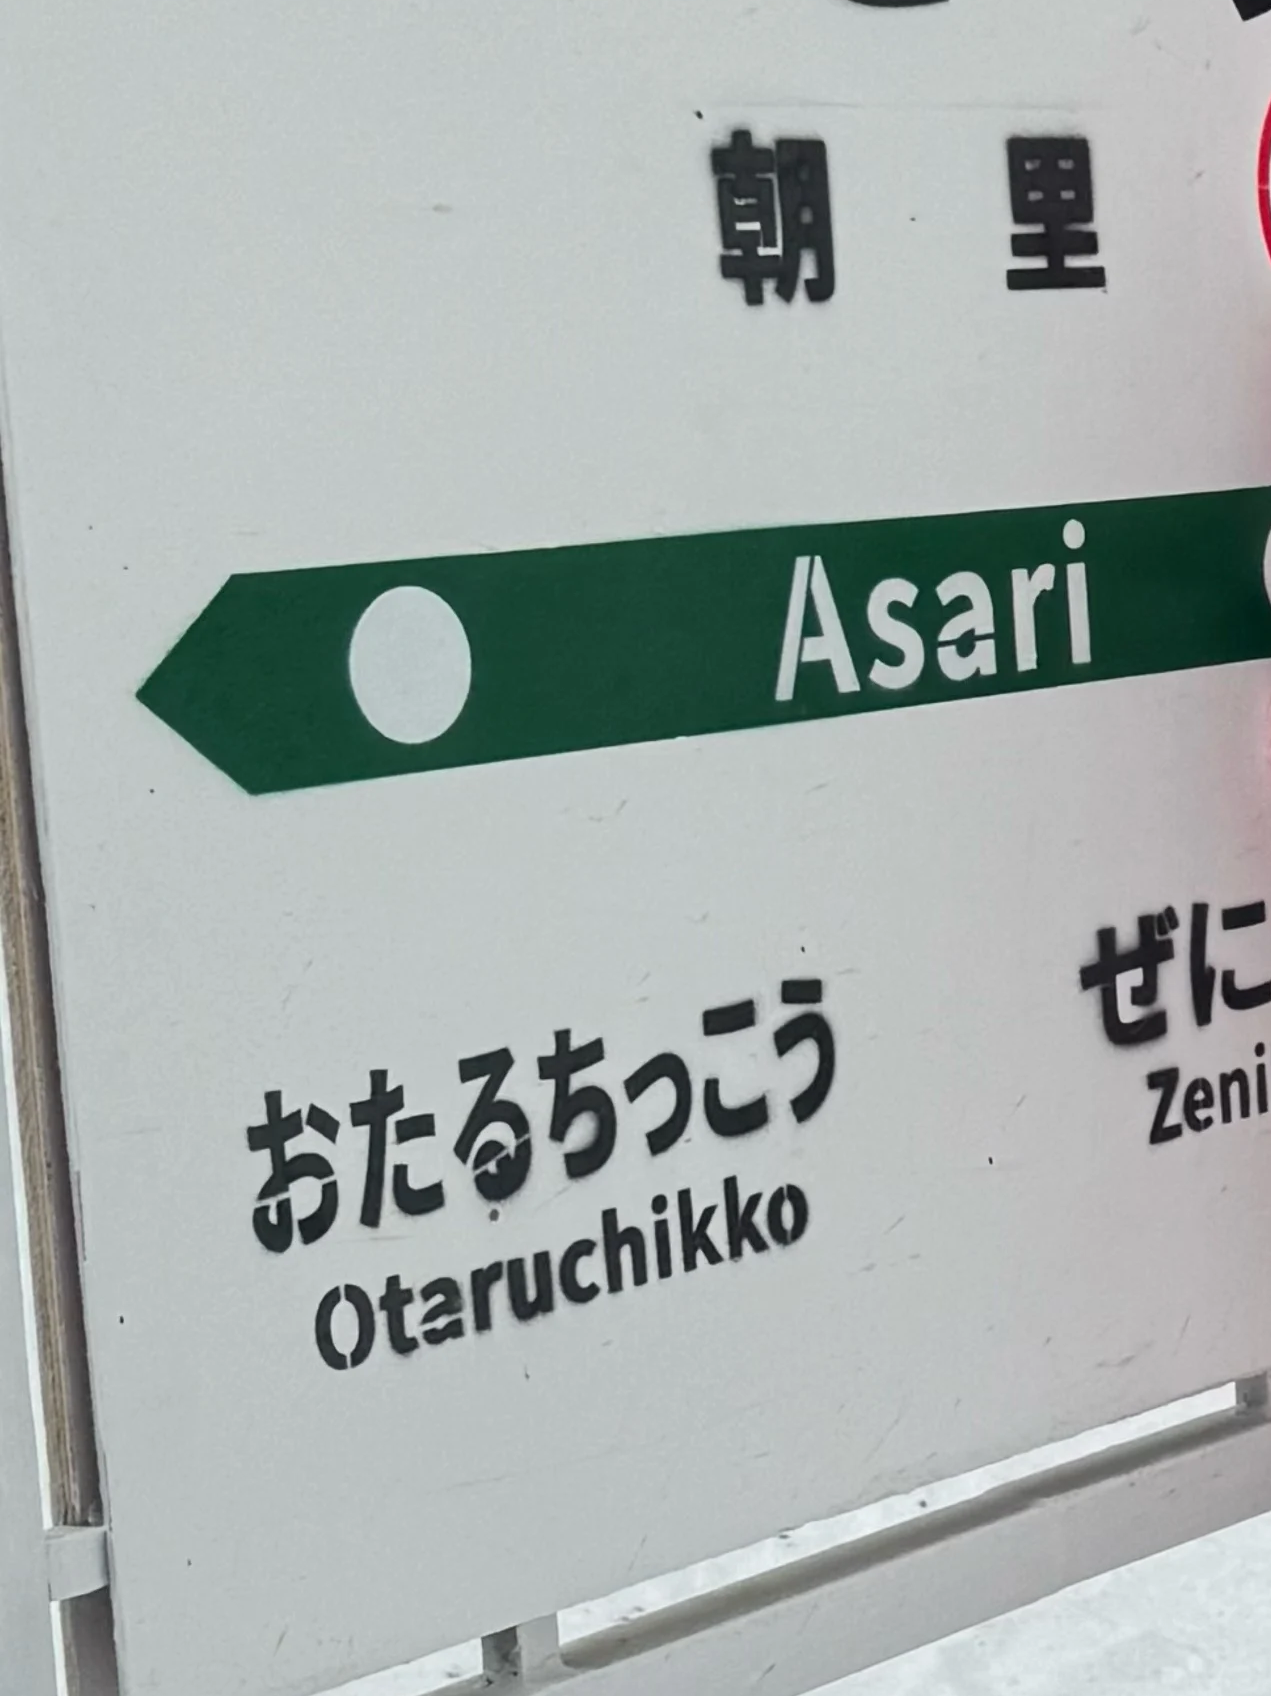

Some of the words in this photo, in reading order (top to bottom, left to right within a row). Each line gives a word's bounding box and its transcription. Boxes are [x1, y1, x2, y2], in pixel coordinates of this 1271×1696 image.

[710, 129, 1106, 307] 朝里
[775, 519, 1093, 702] Asari
[247, 979, 836, 1253] おたるちっこう
[314, 1171, 810, 1371] Otaruchikko
